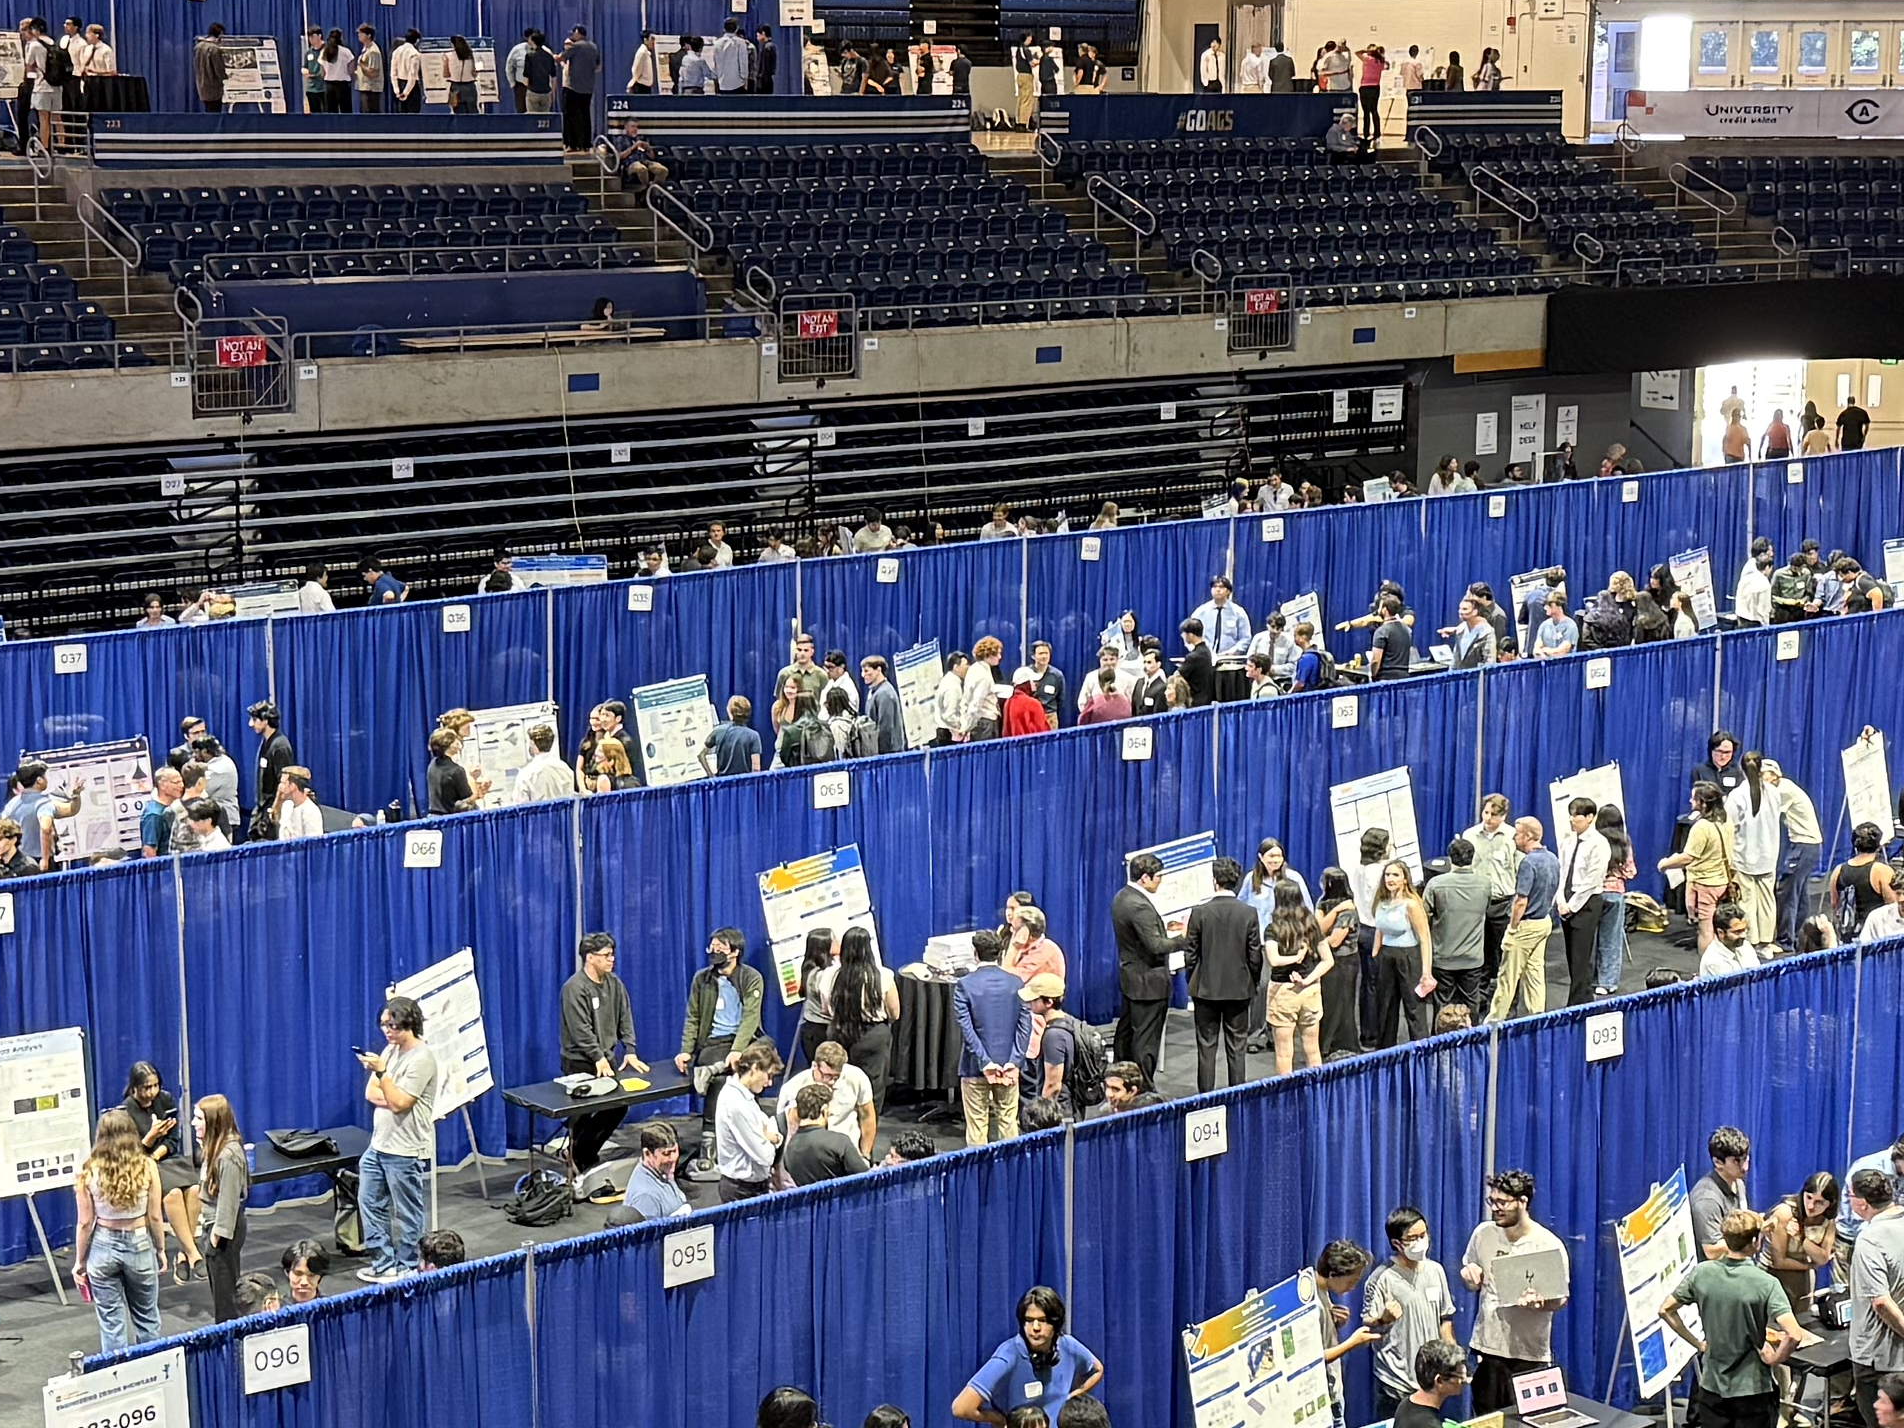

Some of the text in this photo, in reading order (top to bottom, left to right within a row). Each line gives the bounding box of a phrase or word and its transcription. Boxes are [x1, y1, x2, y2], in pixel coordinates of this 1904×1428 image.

[612, 101, 628, 110] 224
[952, 100, 967, 108] 224
[1178, 110, 1234, 132] #GOAGS
[804, 314, 820, 324] NOT
[222, 340, 262, 352] NOT AN
[231, 352, 254, 362] EXIT
[60, 653, 82, 664] 037
[820, 783, 844, 797] 065
[412, 842, 436, 856] 066
[1593, 1026, 1619, 1045] 093
[1193, 1122, 1220, 1144] 094
[672, 1241, 706, 1268] 095
[254, 1344, 300, 1372] 096
